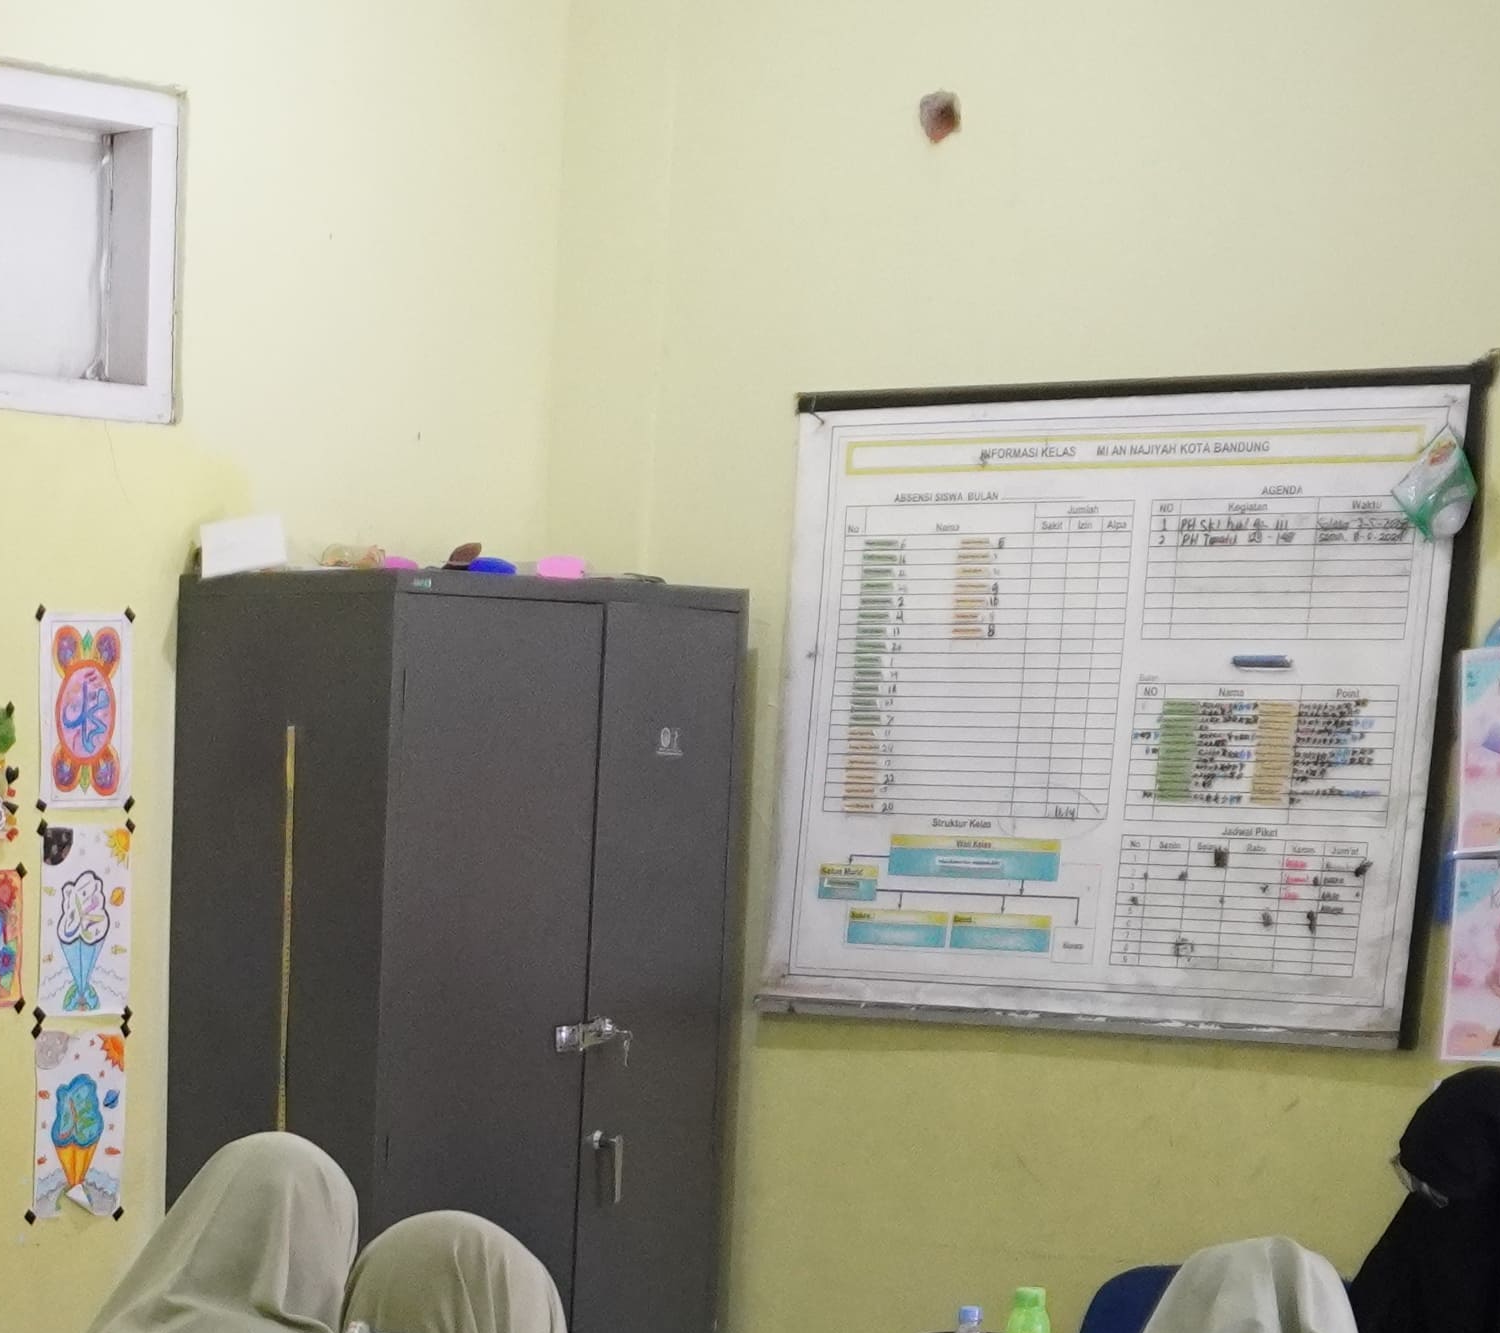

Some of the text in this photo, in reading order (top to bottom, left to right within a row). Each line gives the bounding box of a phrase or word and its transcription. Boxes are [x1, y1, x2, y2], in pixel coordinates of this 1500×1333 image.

[1041, 446, 1077, 459] KELAS
[1097, 446, 1108, 456] MI
[1111, 445, 1127, 456] AN
[1130, 443, 1176, 456] NAJIYAH
[1179, 442, 1212, 454] KOTA
[1214, 441, 1270, 453] BANDUNG
[1262, 485, 1303, 496] AGENDA
[894, 491, 999, 503] ABSENSI SISWA BULAN
[1067, 503, 1099, 514] Jumlah
[936, 522, 960, 532] Nama
[1106, 519, 1127, 530] Alpa
[1143, 687, 1158, 697] NO
[1219, 688, 1245, 697] Nama
[932, 818, 991, 829] Struktur Kelas
